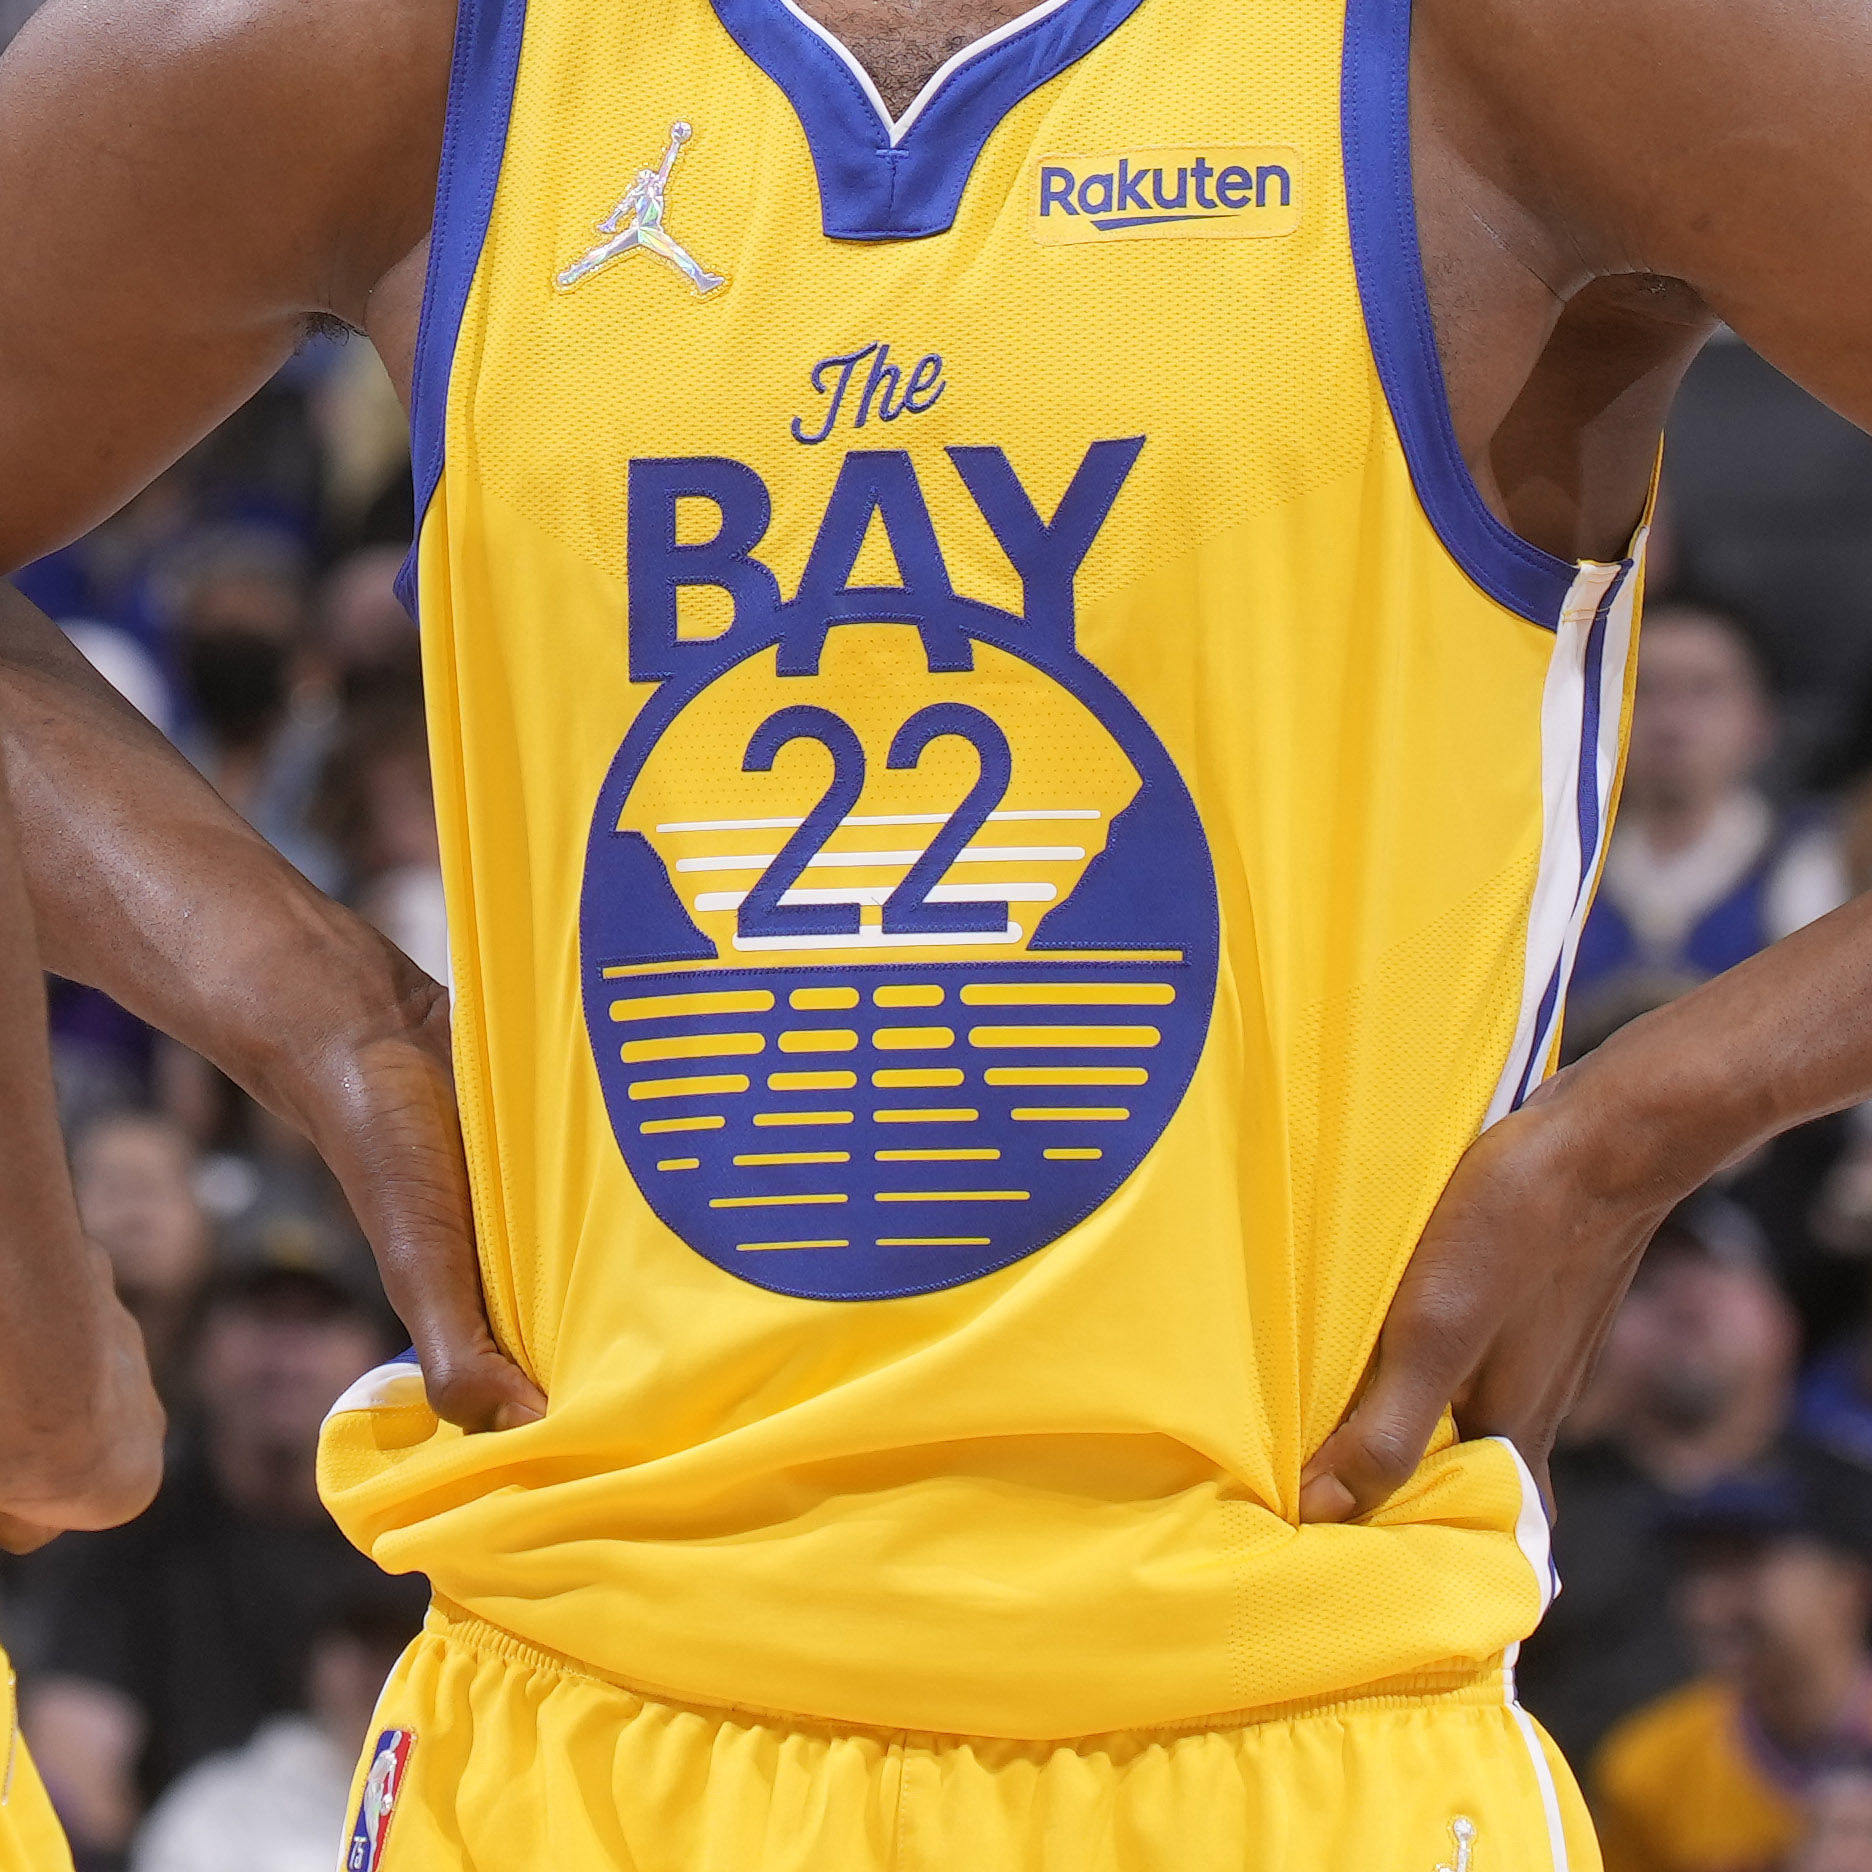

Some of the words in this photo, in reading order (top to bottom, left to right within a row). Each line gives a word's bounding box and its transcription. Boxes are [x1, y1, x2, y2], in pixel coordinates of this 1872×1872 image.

[1039, 156, 1291, 217] Rakuten
[790, 340, 946, 445] The
[628, 434, 1147, 683] BAY
[737, 702, 1012, 938] 22
